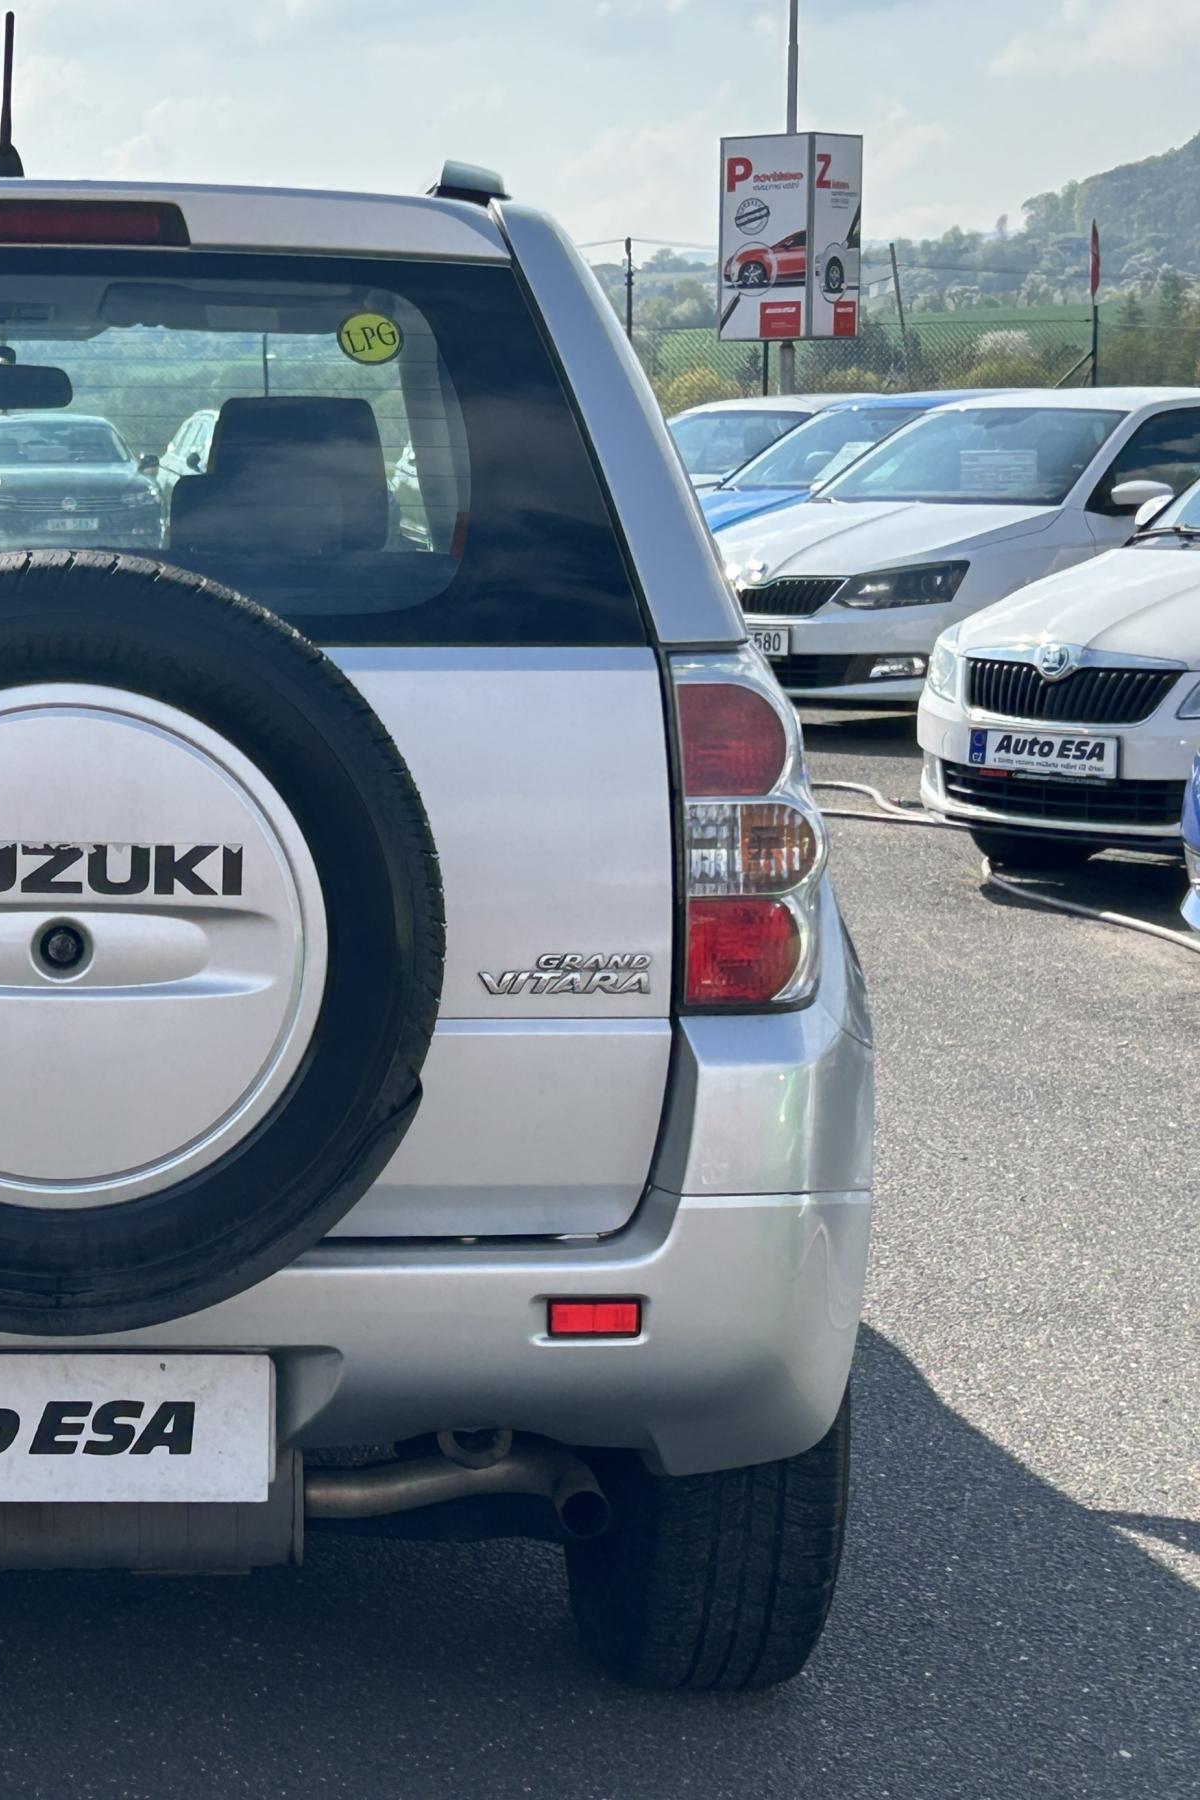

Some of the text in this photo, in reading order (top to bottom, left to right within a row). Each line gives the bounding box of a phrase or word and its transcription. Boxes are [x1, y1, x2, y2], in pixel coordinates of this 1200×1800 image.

[344, 322, 397, 354] LPG
[747, 632, 782, 652] 580
[993, 734, 1106, 762] Auto ESA
[536, 953, 652, 971] GRAND
[477, 970, 652, 995] VITARA
[28, 1399, 196, 1456] ESA
